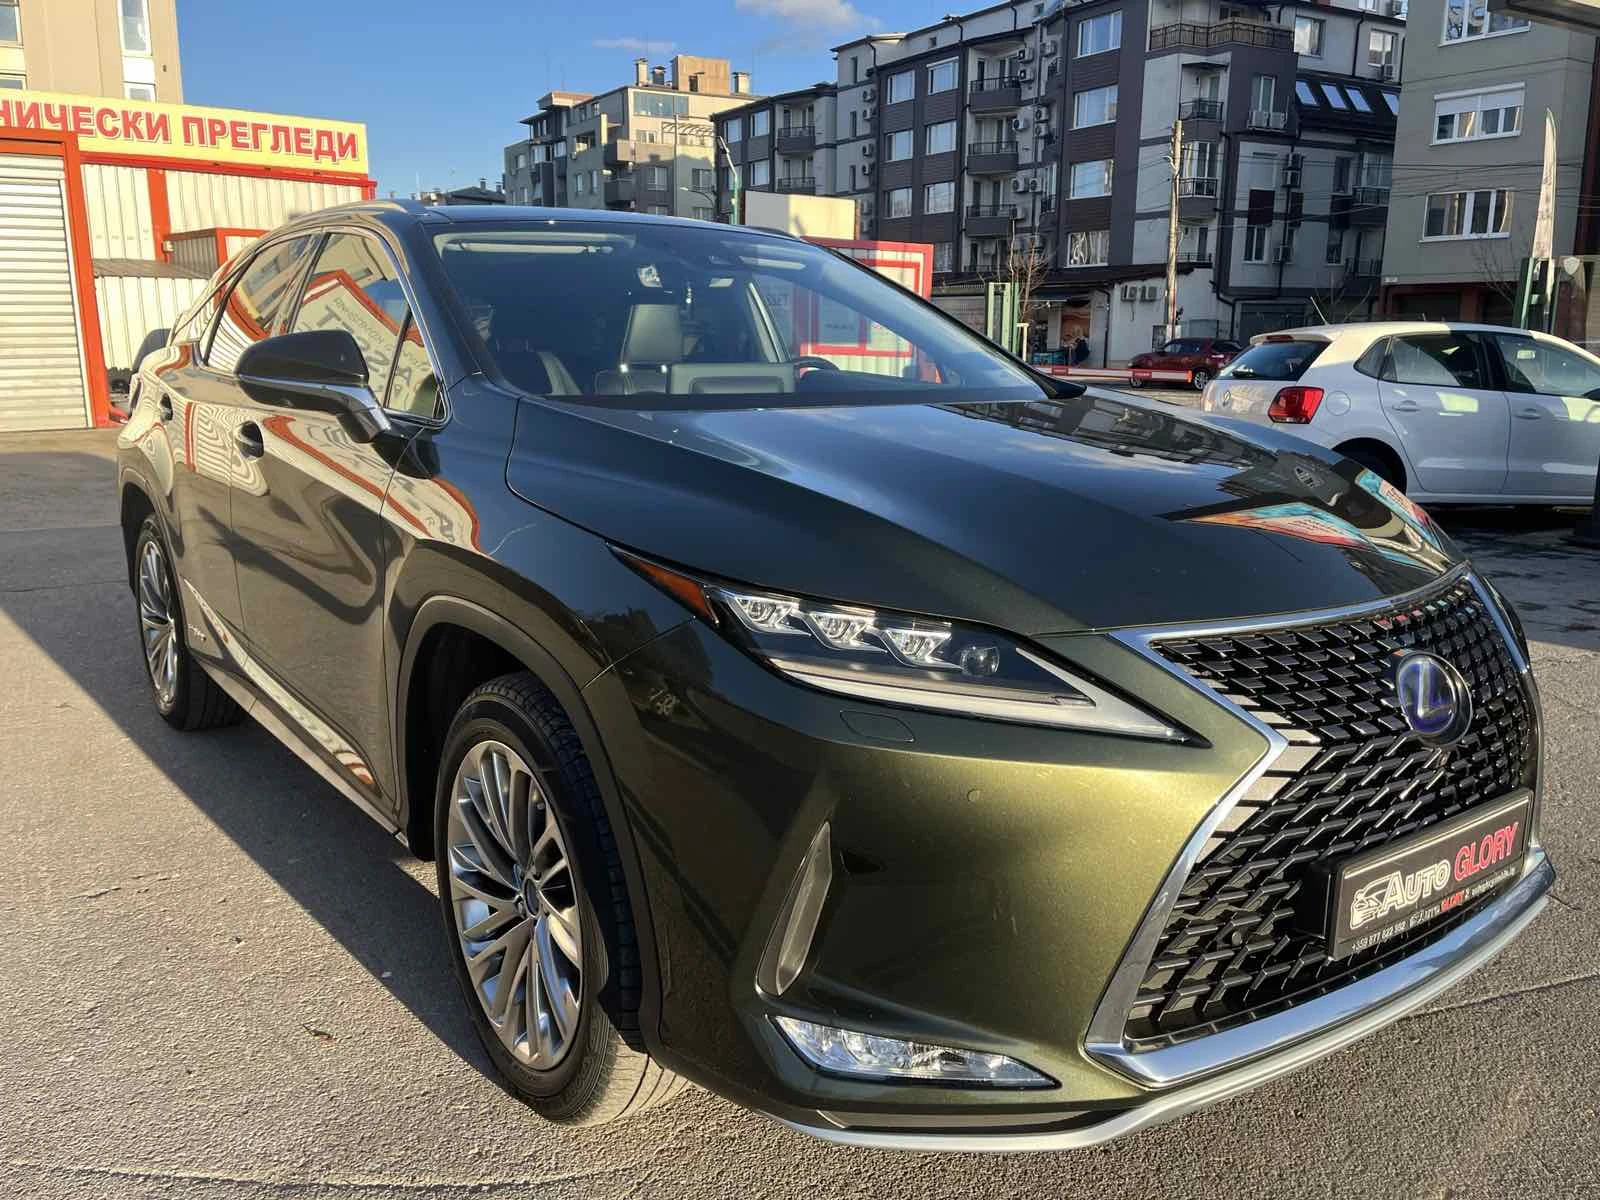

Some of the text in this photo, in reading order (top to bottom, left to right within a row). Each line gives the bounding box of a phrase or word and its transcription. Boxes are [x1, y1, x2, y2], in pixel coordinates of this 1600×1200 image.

[182, 116, 359, 162] ПРЕГЛЕДИ
[1376, 860, 1451, 917] AUTO
[1454, 821, 1519, 881] GLORY
